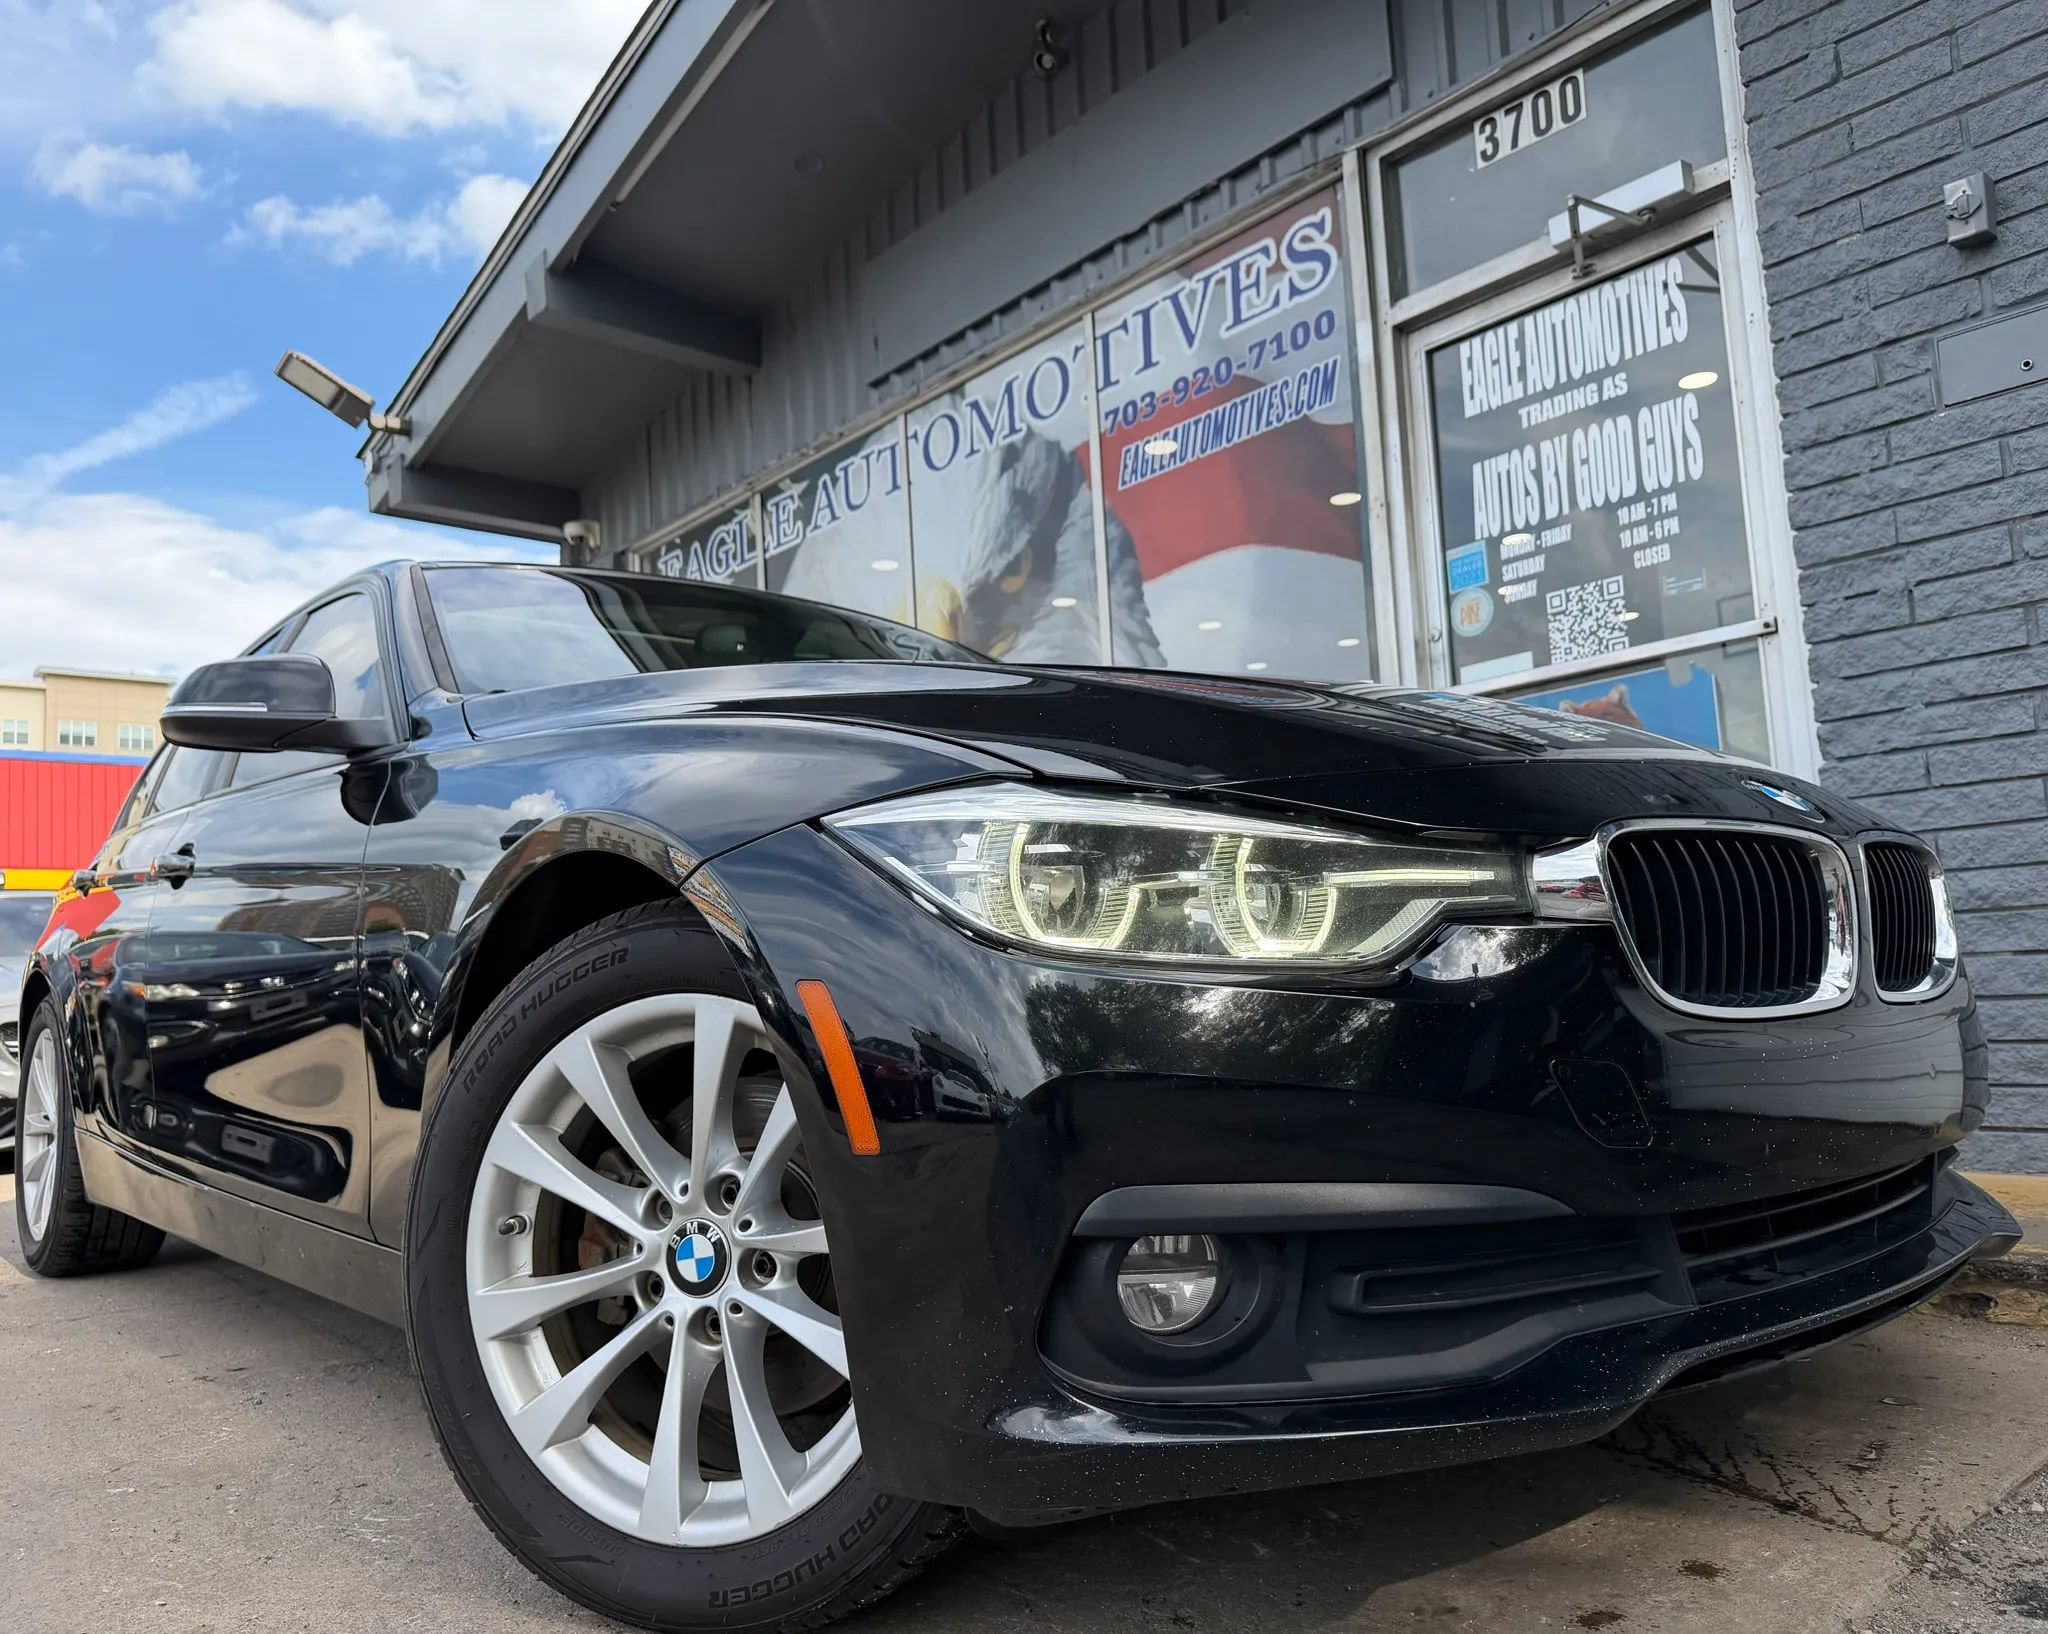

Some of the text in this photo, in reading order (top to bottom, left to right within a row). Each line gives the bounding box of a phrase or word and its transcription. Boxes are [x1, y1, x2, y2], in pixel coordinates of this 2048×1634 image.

[1477, 75, 1583, 163] 3700
[805, 206, 1337, 536] AUTOMOTIVES
[1103, 309, 1336, 436] 703-920-7100
[1459, 257, 1688, 419] EAGLE AUTOMOTIVES
[1117, 355, 1341, 491] EAGLEAUTOMOTIVES.COM
[1518, 372, 1629, 429] TRADING AS
[1472, 392, 1704, 540] AUTOS BY GOOD GUYS
[1617, 506, 1630, 526] 10
[1630, 501, 1647, 522] AM
[1651, 497, 1659, 516] 7
[1660, 492, 1678, 514] PM
[1502, 553, 1546, 582] SATURDAY
[1541, 523, 1572, 549] FRIDAY
[1619, 529, 1632, 549] 10
[1632, 524, 1649, 545] AM
[1654, 520, 1663, 540] 6
[1662, 516, 1680, 537] PM
[1633, 543, 1671, 570] CLOSED
[462, 948, 630, 1094] ROAD HUGGER
[669, 1221, 721, 1250] BMW
[708, 1493, 895, 1609] OAD HUGGER
